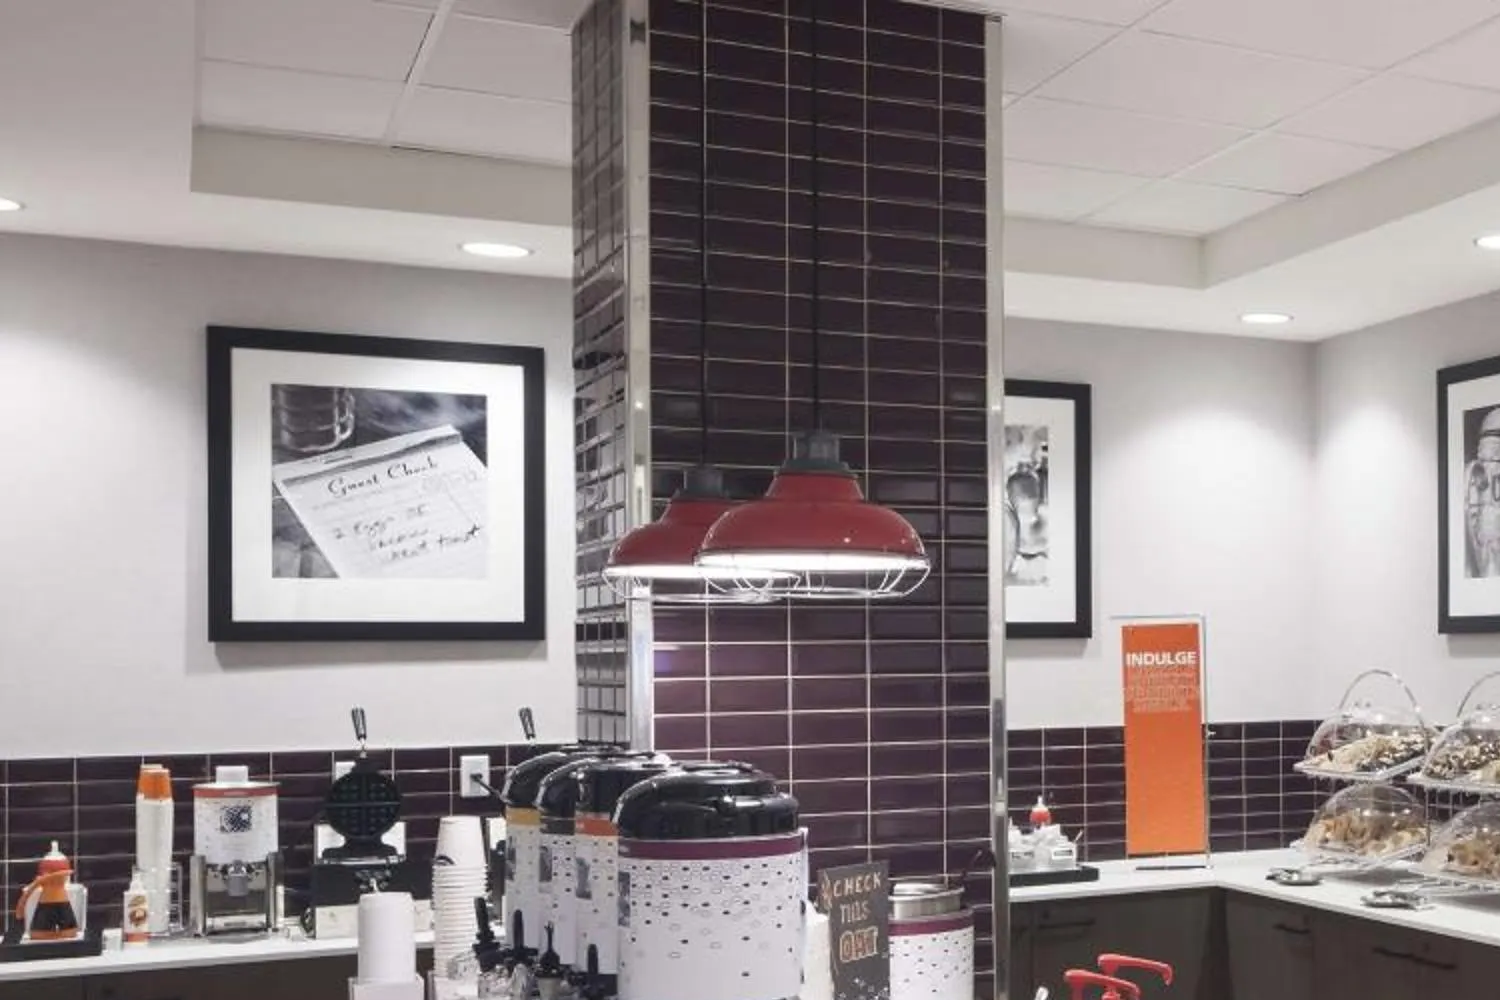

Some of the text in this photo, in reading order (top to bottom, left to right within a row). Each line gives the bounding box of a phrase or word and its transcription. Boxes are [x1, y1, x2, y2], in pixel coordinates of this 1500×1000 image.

[1125, 650, 1197, 666] INDULGE
[833, 871, 882, 898] CHECK
[839, 900, 871, 925] THIS
